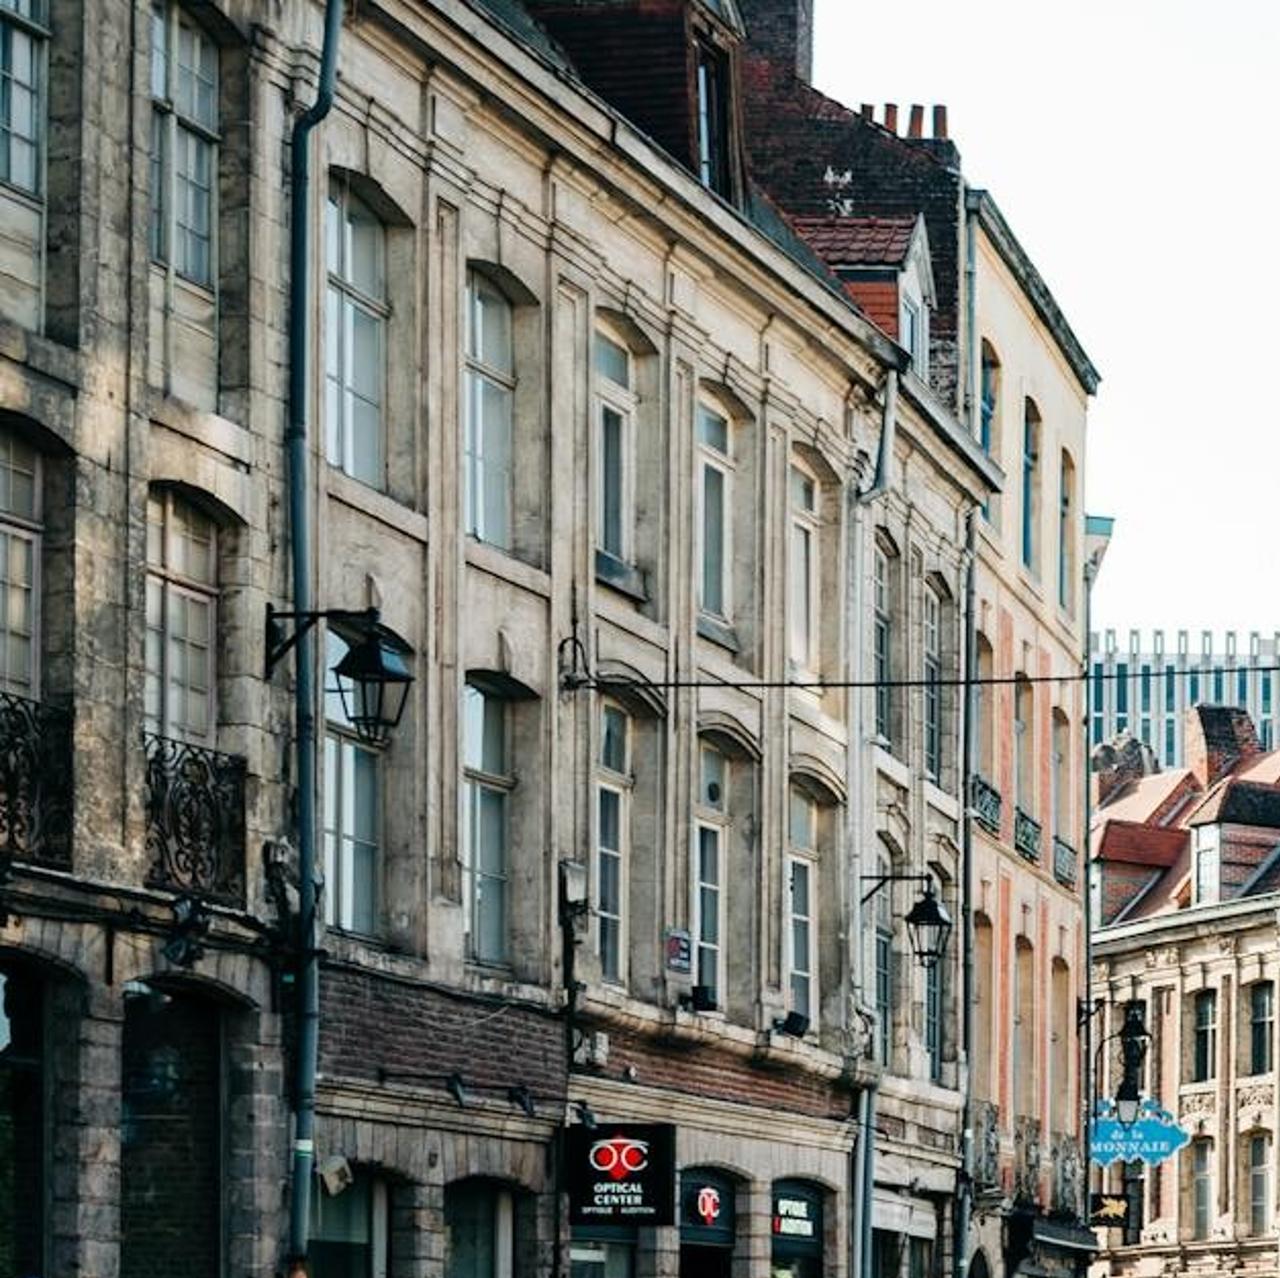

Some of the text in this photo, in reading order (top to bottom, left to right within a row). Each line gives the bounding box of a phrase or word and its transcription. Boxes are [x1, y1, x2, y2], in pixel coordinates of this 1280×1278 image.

[1090, 1142, 1169, 1153] MONNAIE
[593, 1182, 643, 1193] OPTICAL
[593, 1195, 642, 1205] CENTER
